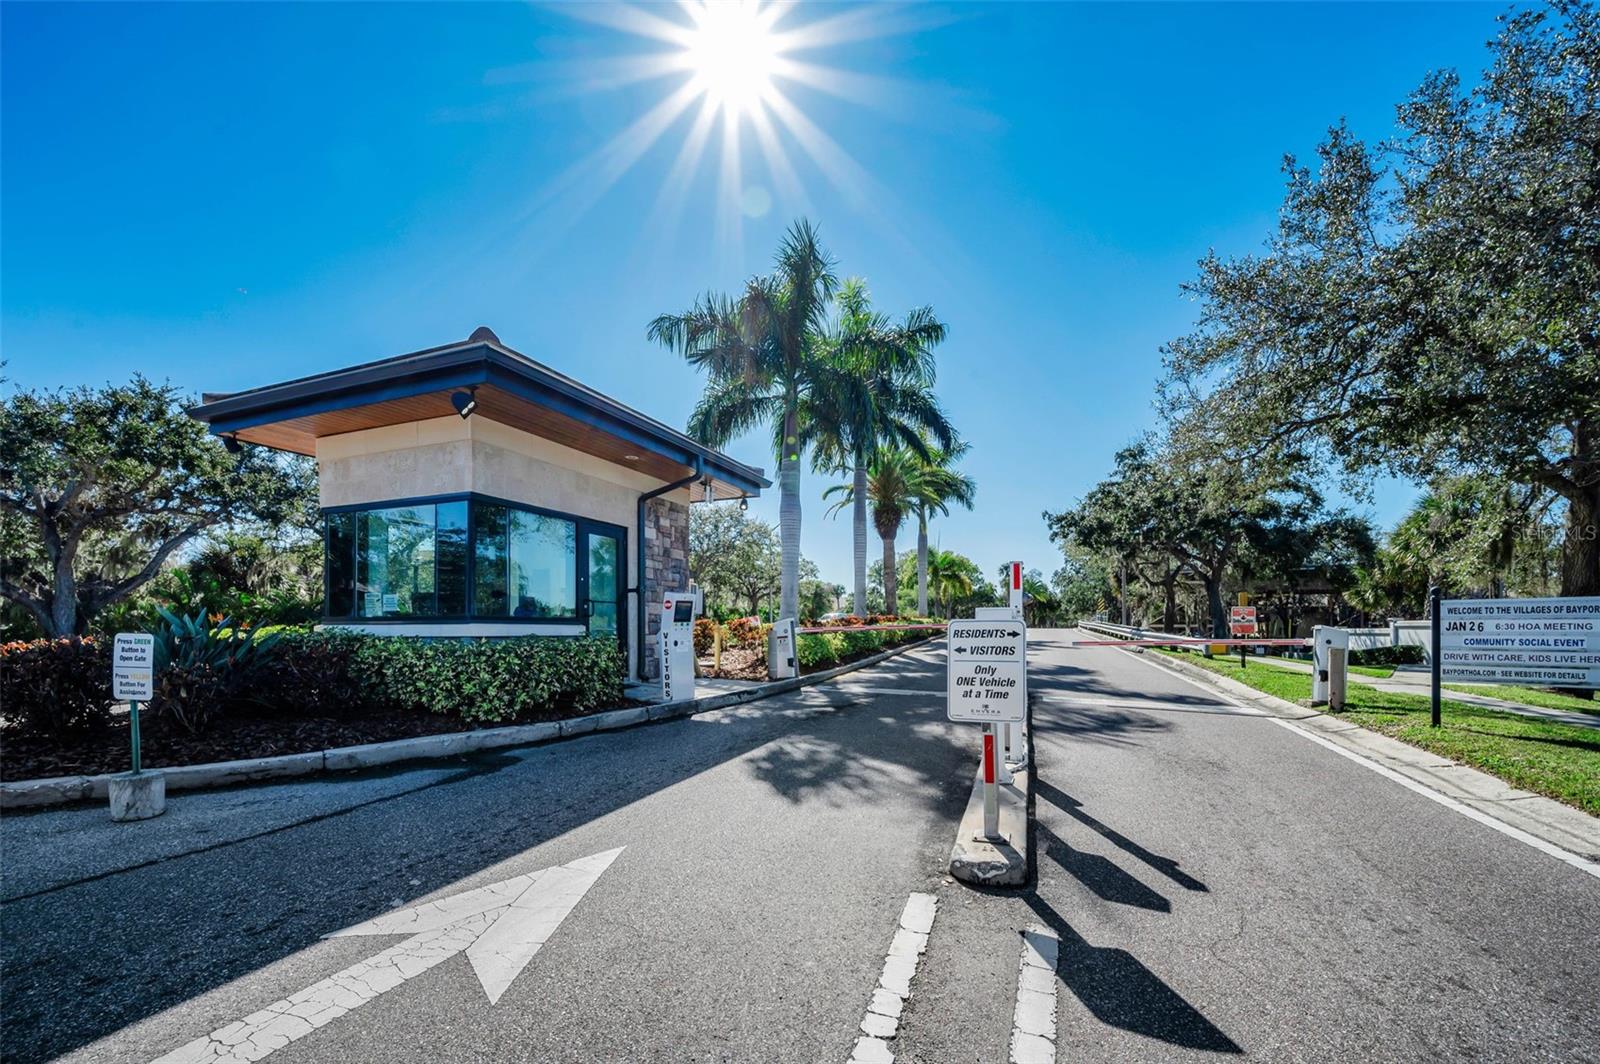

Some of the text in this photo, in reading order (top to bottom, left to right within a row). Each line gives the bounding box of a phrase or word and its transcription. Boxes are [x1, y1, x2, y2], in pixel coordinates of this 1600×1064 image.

[1447, 607, 1482, 615] WELCOME
[1484, 606, 1494, 614] TO
[1496, 606, 1511, 614] THE
[1513, 606, 1551, 614] VILLAGES
[1445, 621, 1467, 632] JAN
[1495, 623, 1515, 631] 6:30
[1518, 623, 1541, 631] HOA
[1543, 623, 1593, 631] MEETING
[953, 629, 1006, 639] RESIDENTS
[1464, 638, 1585, 647] COMMUNITY SOCIAL EVENT
[970, 646, 1016, 656] VISITORS
[1443, 653, 1469, 661] DRIVE
[1497, 654, 1526, 662] CARE,
[1528, 655, 1551, 663] KIDS
[1554, 655, 1577, 663] LIVE
[663, 632, 671, 698] VISITORS
[974, 665, 997, 676] Only
[1442, 668, 1497, 677] BAYPORTHOA.COM
[1543, 671, 1556, 679] FOR
[1557, 672, 1586, 680] DETAILS
[956, 677, 1016, 687] ONE Vehicle
[962, 689, 972, 698] at
[985, 689, 1009, 699] Time
